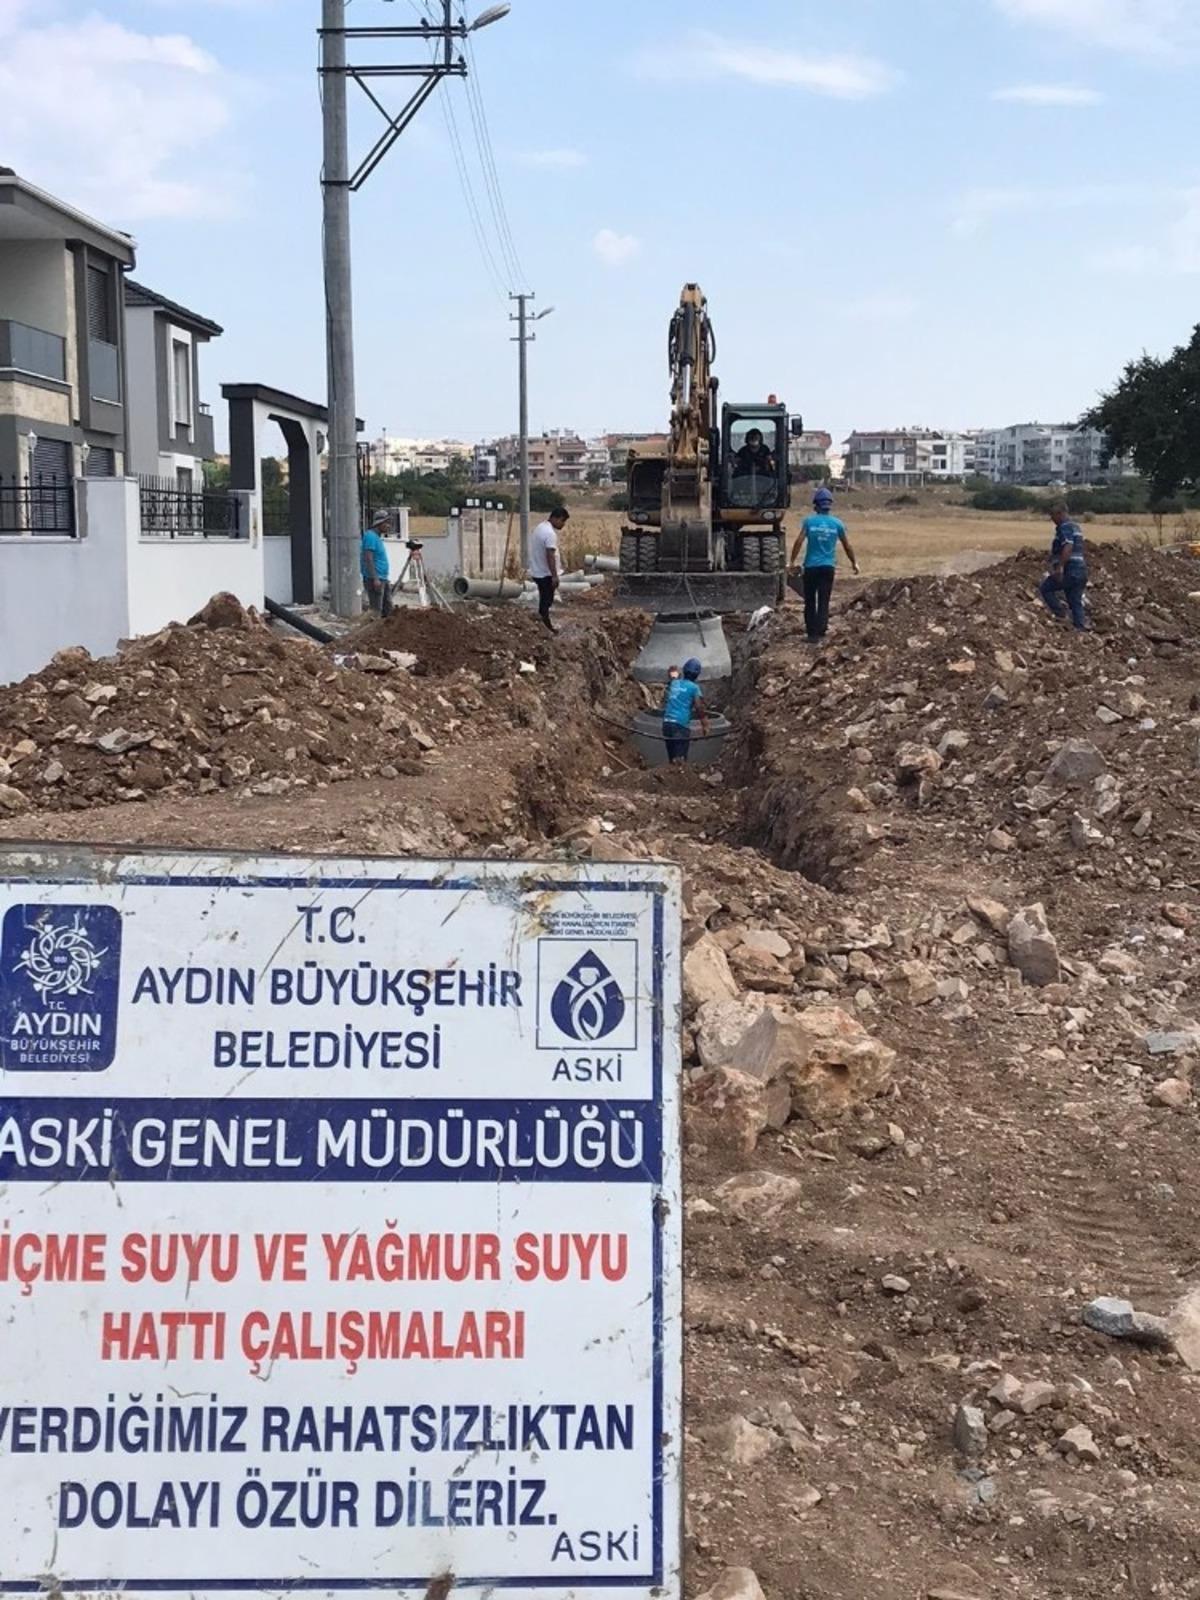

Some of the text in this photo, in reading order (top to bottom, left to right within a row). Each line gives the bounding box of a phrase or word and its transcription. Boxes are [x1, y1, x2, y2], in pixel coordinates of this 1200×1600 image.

[296, 904, 366, 944] T.C.
[131, 960, 523, 1017] AYDIN BÜYÜKŞEHİR
[10, 1038, 101, 1053] BÜYÜKŞEHİR
[11, 1012, 102, 1036] AYDIN
[213, 1023, 441, 1070] BELEDİYESİ
[19, 1052, 91, 1064] BELEDİYESİ
[551, 1053, 622, 1082] ASKİ
[0, 1104, 644, 1168] ASKİ GENEL MÜDÜRLÜĞÜ
[0, 1219, 628, 1297] İÇME SUYU VE YAĞMUR SUYU
[101, 1310, 525, 1376] HATTI ÇALIŞMALARI
[262, 1404, 634, 1454] RAHATSIZLIKTAN
[58, 1465, 558, 1529] DOLAYI ÖZÜR DİLERİZ.
[550, 1524, 639, 1563] ASKİ
